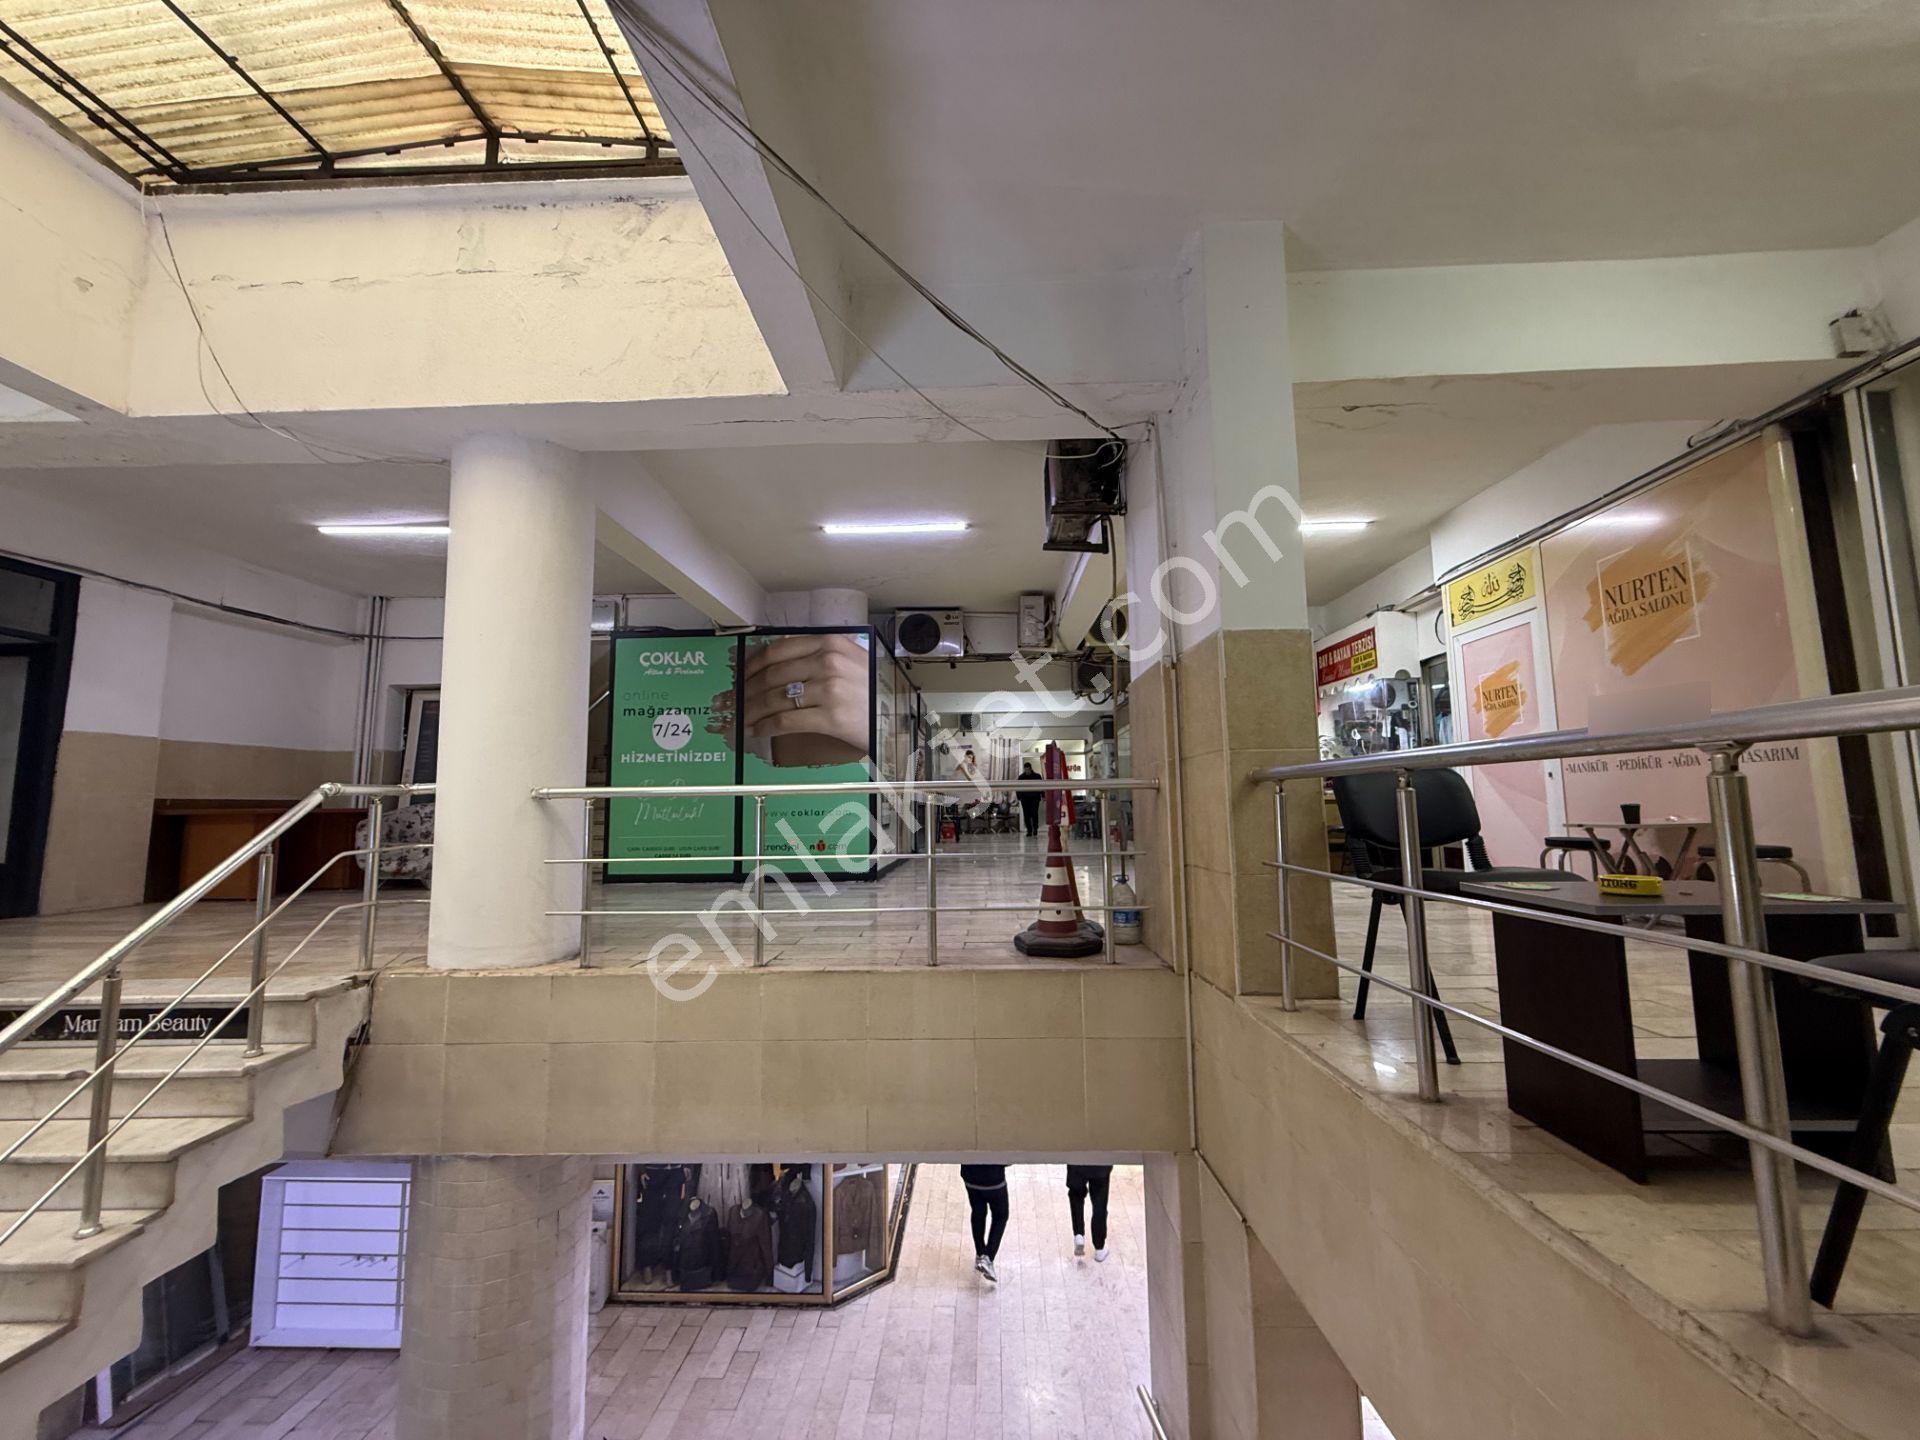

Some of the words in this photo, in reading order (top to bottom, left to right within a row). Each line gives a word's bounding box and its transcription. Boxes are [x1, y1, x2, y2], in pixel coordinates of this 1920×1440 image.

[1604, 562, 1688, 610] NURTEN
[1607, 606, 1637, 626] AĞDA
[1639, 589, 1689, 617] SALONU
[623, 690, 669, 701] online
[1482, 683, 1518, 702] NURTEN
[623, 705, 710, 718] mağazamız
[653, 722, 692, 738] 7/24
[620, 750, 726, 763] HİZMETİNİZDE!
[1618, 754, 1662, 770] PEDİKÜR
[1672, 752, 1701, 767] AĞDA
[64, 1014, 142, 1033] Maram
[149, 1014, 212, 1038] Beauty
